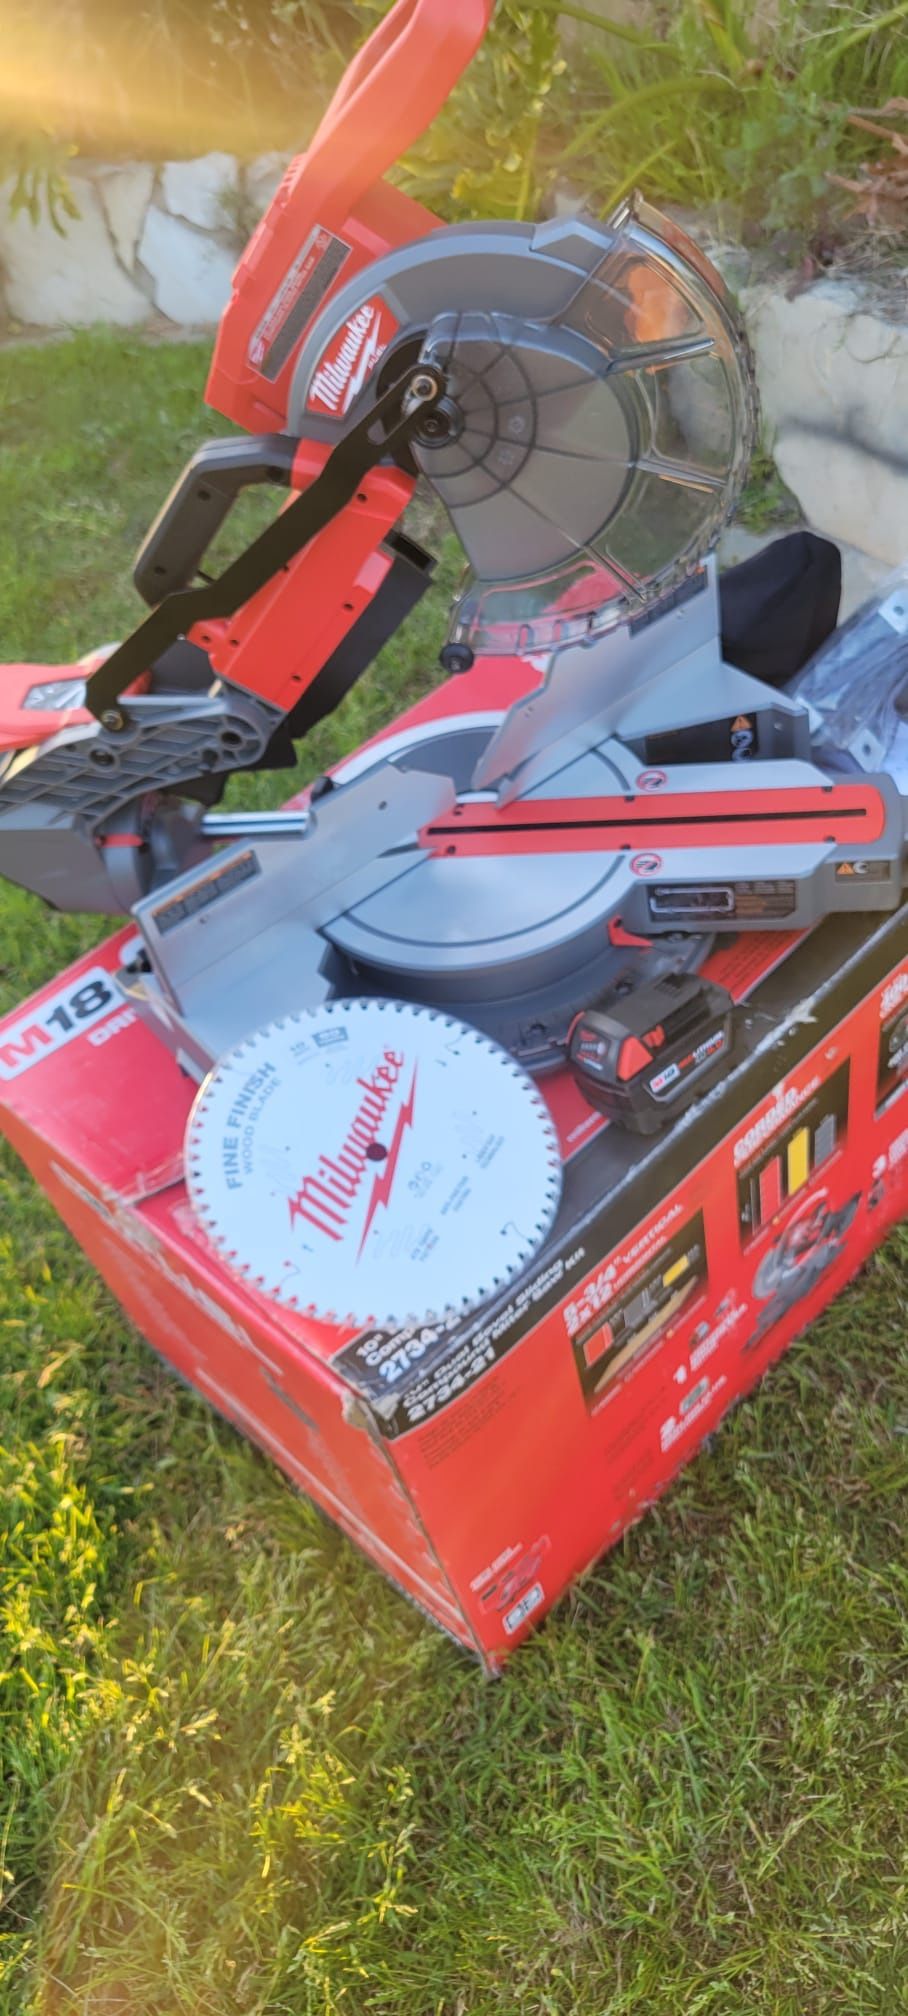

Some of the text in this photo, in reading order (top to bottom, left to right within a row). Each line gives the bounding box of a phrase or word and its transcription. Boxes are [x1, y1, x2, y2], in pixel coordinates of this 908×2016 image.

[309, 305, 375, 411] Milwaukee
[0, 980, 112, 1068] M18
[223, 1062, 276, 1189] FINE FINISH
[242, 1077, 281, 1175] WOOD BLADE
[287, 1050, 404, 1242] Milwaukee
[622, 1203, 683, 1264] VERTICAL
[402, 1338, 491, 1408] Compound
[492, 1300, 530, 1340] Miter
[531, 1268, 563, 1301] Saw
[434, 1345, 470, 1380] Dual
[472, 1304, 514, 1347] Bevel
[516, 1259, 563, 1306] Sliding
[407, 1346, 495, 1421] 2734-21
